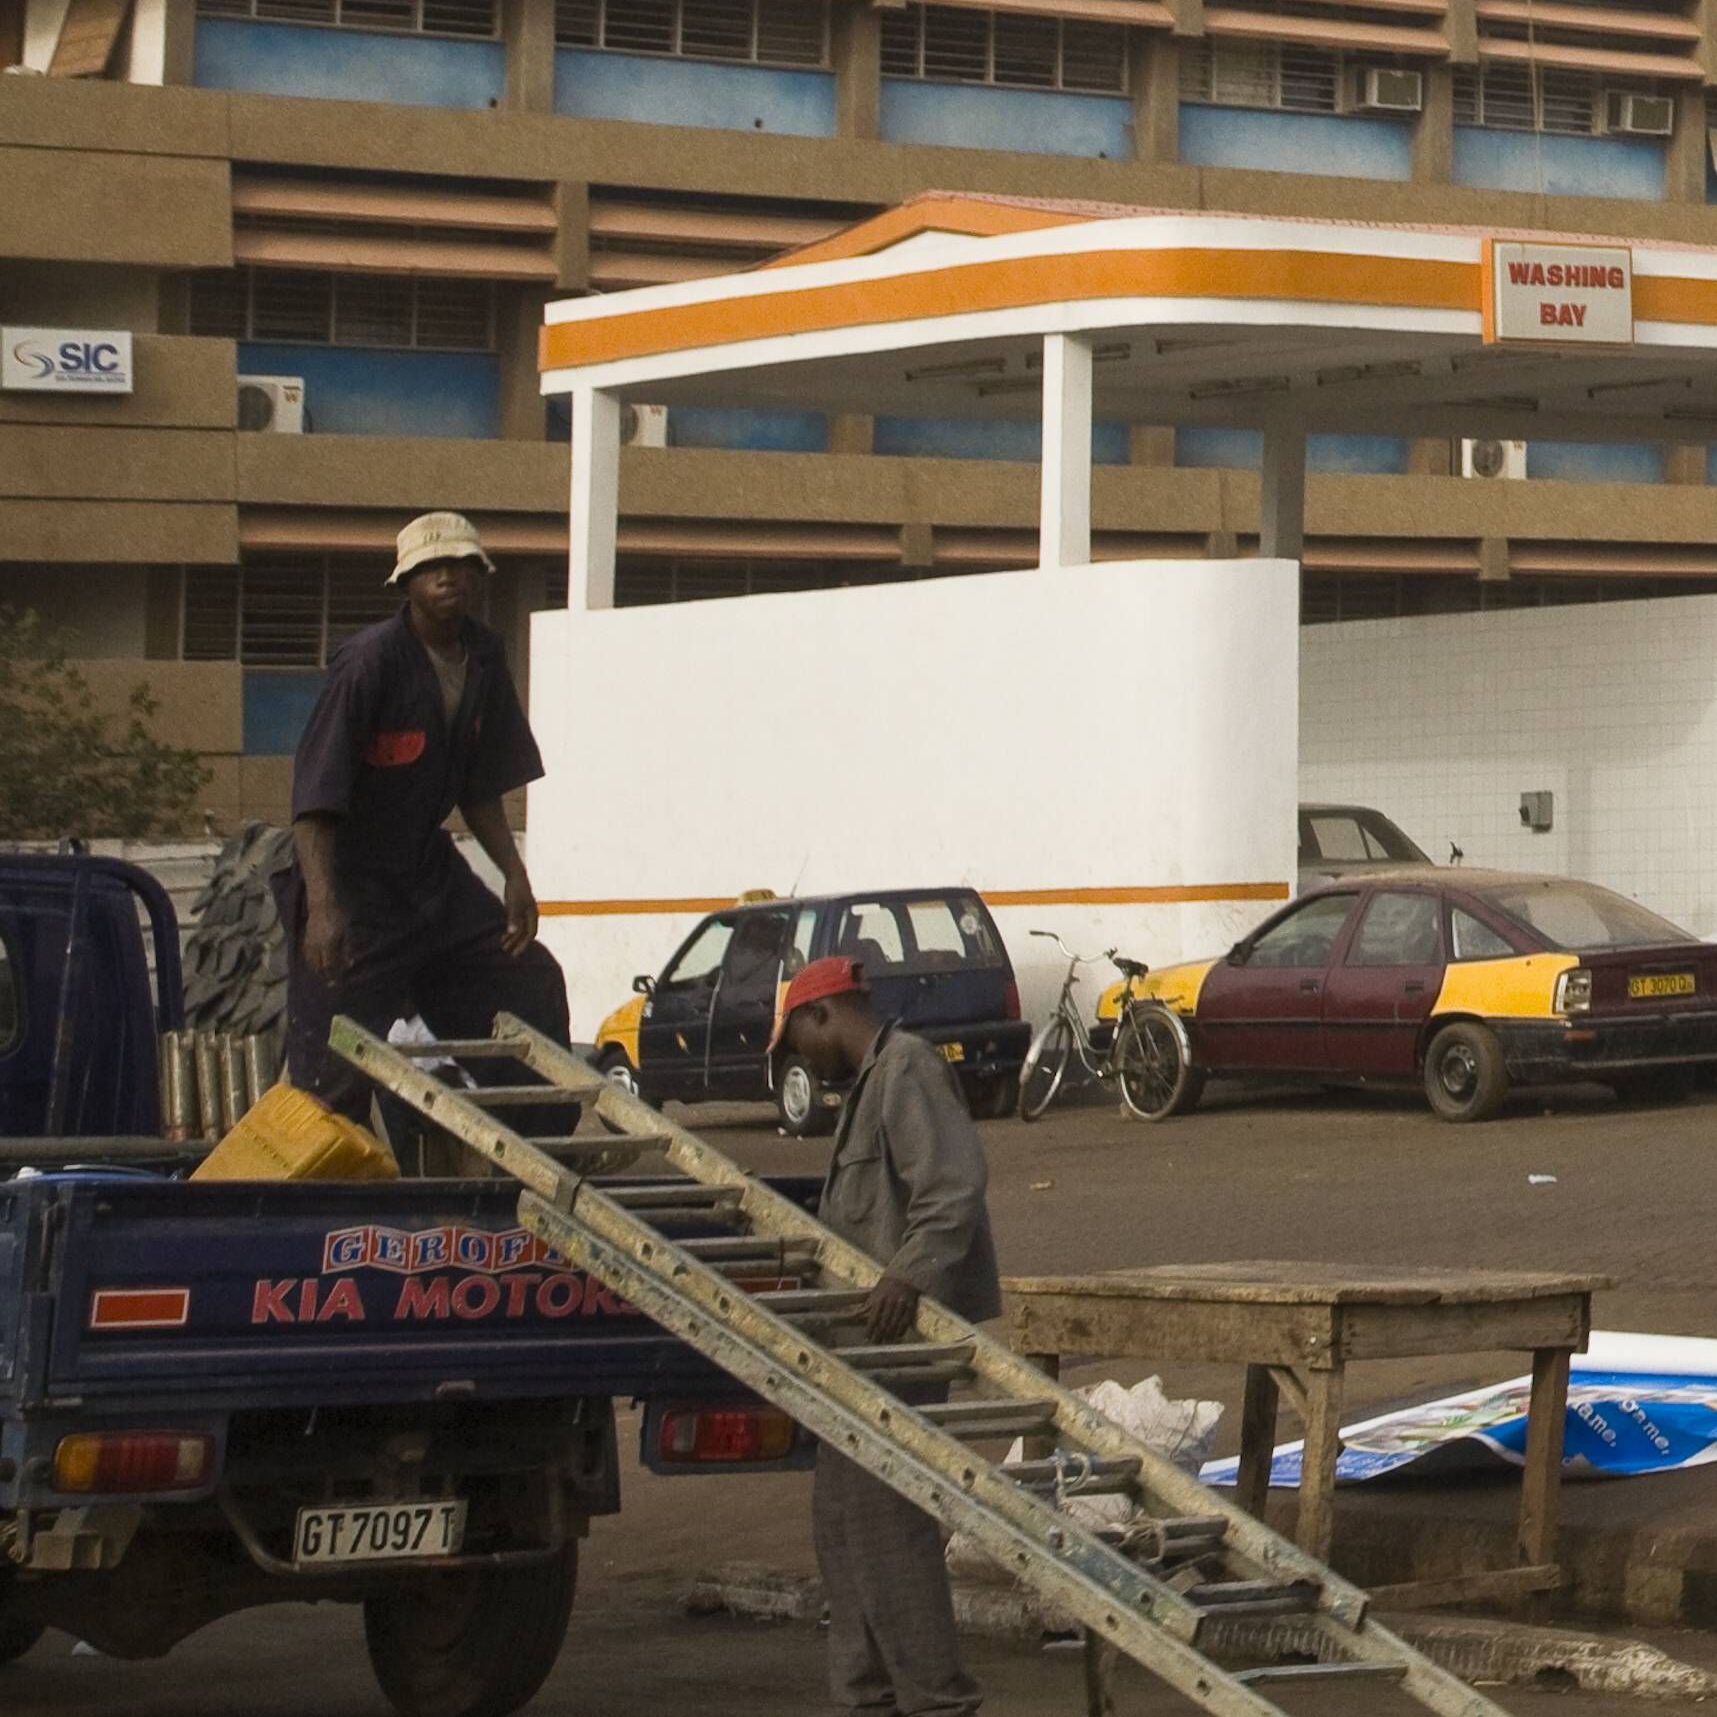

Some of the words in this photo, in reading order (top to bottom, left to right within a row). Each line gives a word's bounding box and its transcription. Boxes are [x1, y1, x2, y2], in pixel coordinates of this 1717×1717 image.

[1508, 263, 1624, 289] WASHING
[1540, 303, 1586, 326] BAY
[59, 343, 118, 372] SIC
[251, 1278, 366, 1324] KIA
[302, 1512, 345, 1556] GT
[349, 1508, 433, 1554] 7097
